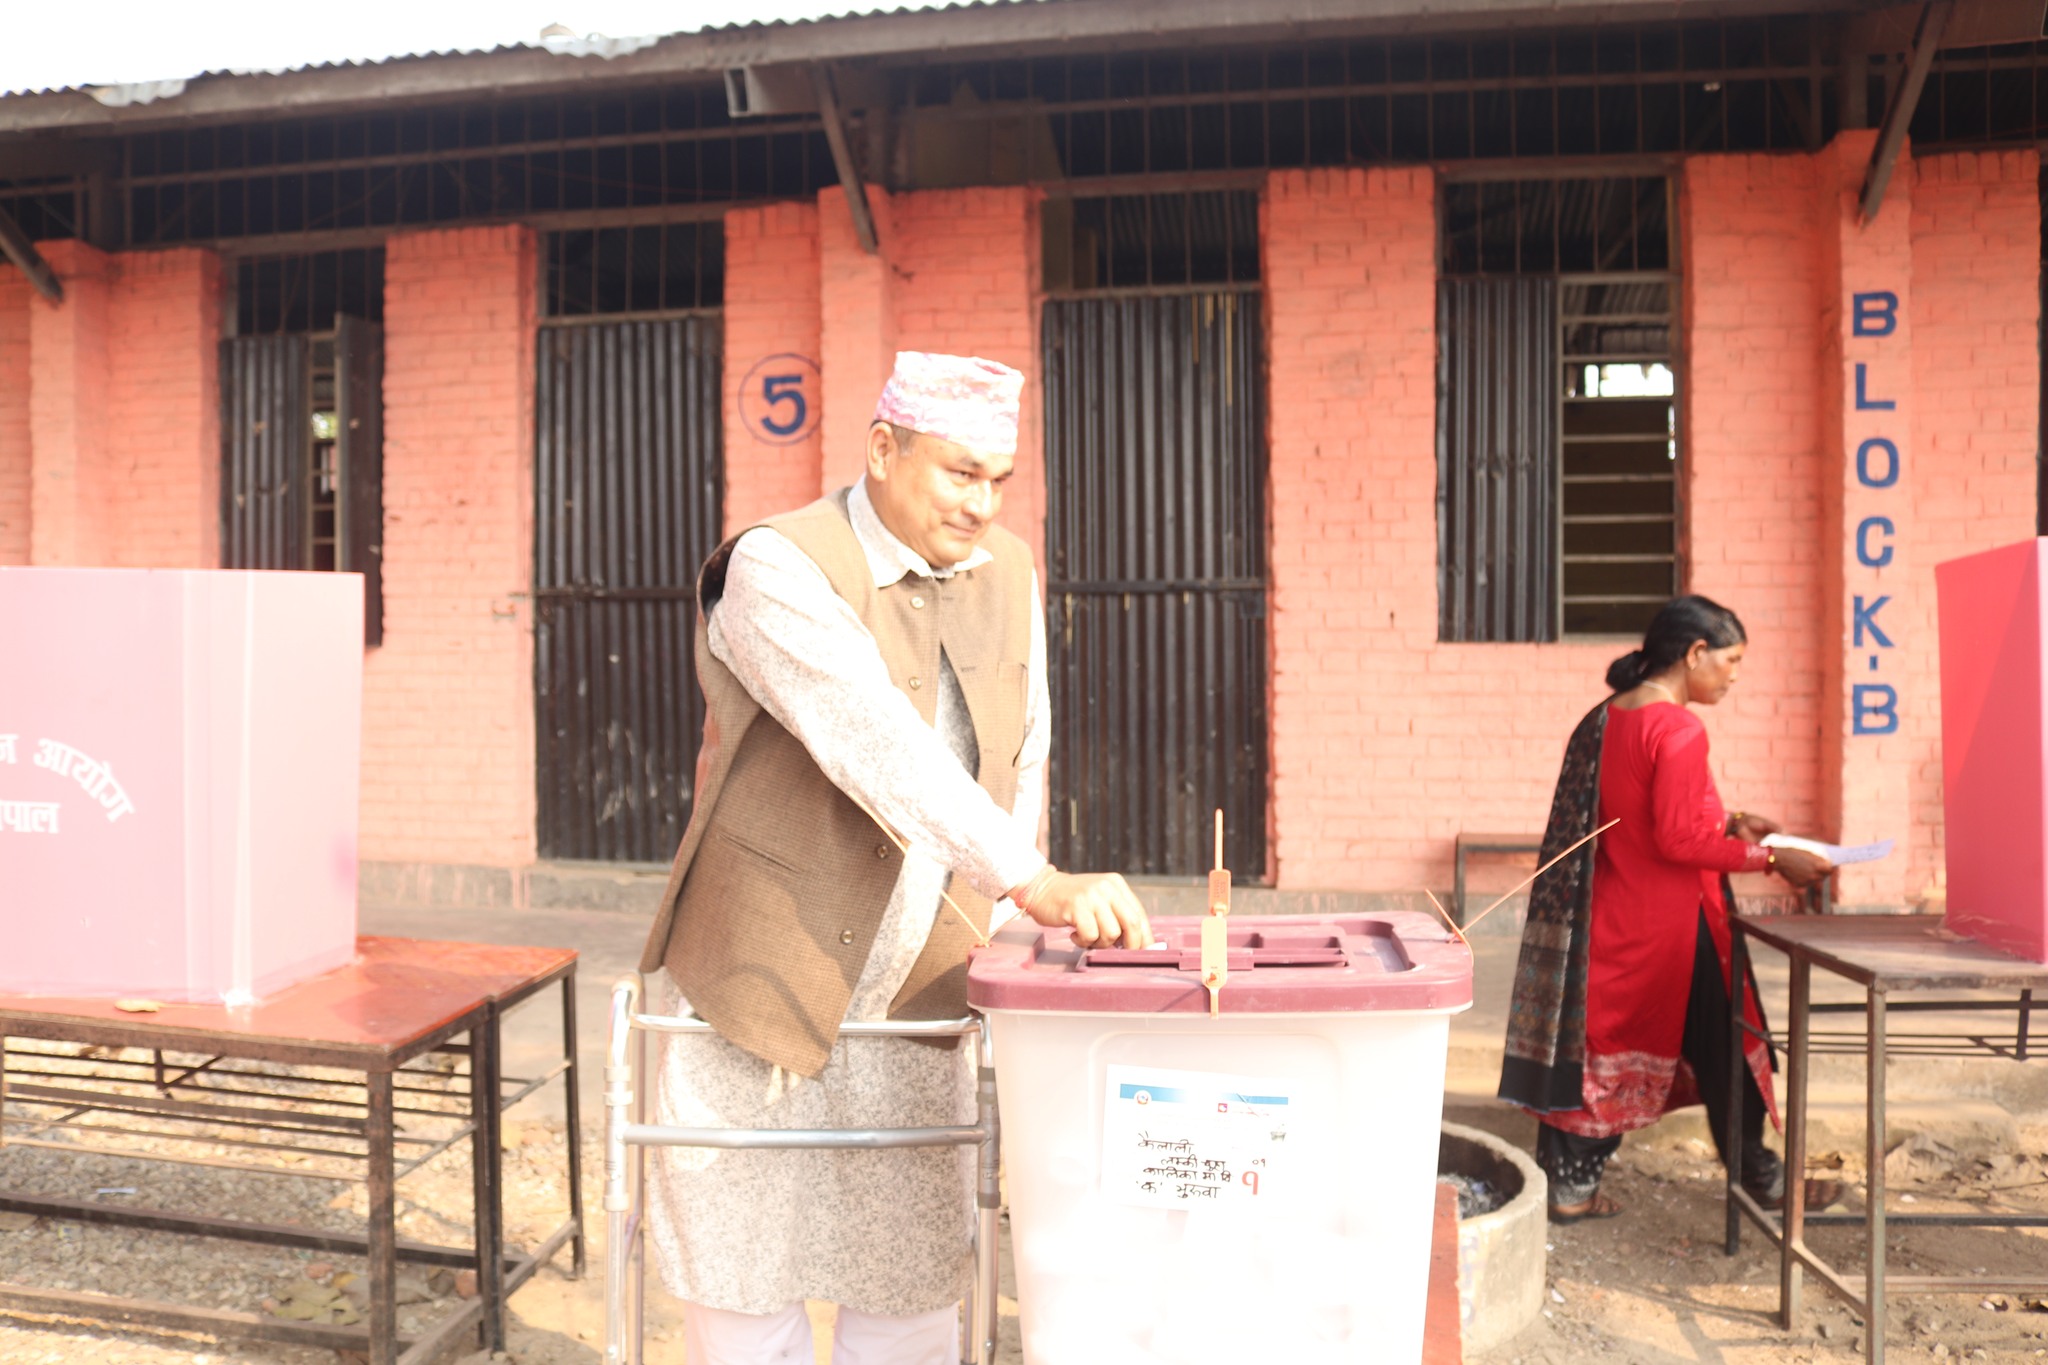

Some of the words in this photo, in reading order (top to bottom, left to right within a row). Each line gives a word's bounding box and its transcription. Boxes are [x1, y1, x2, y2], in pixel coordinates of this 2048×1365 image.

[761, 374, 806, 436] 5
[33, 738, 135, 822] आयोग
[1138, 1131, 1195, 1154] कैलाली
